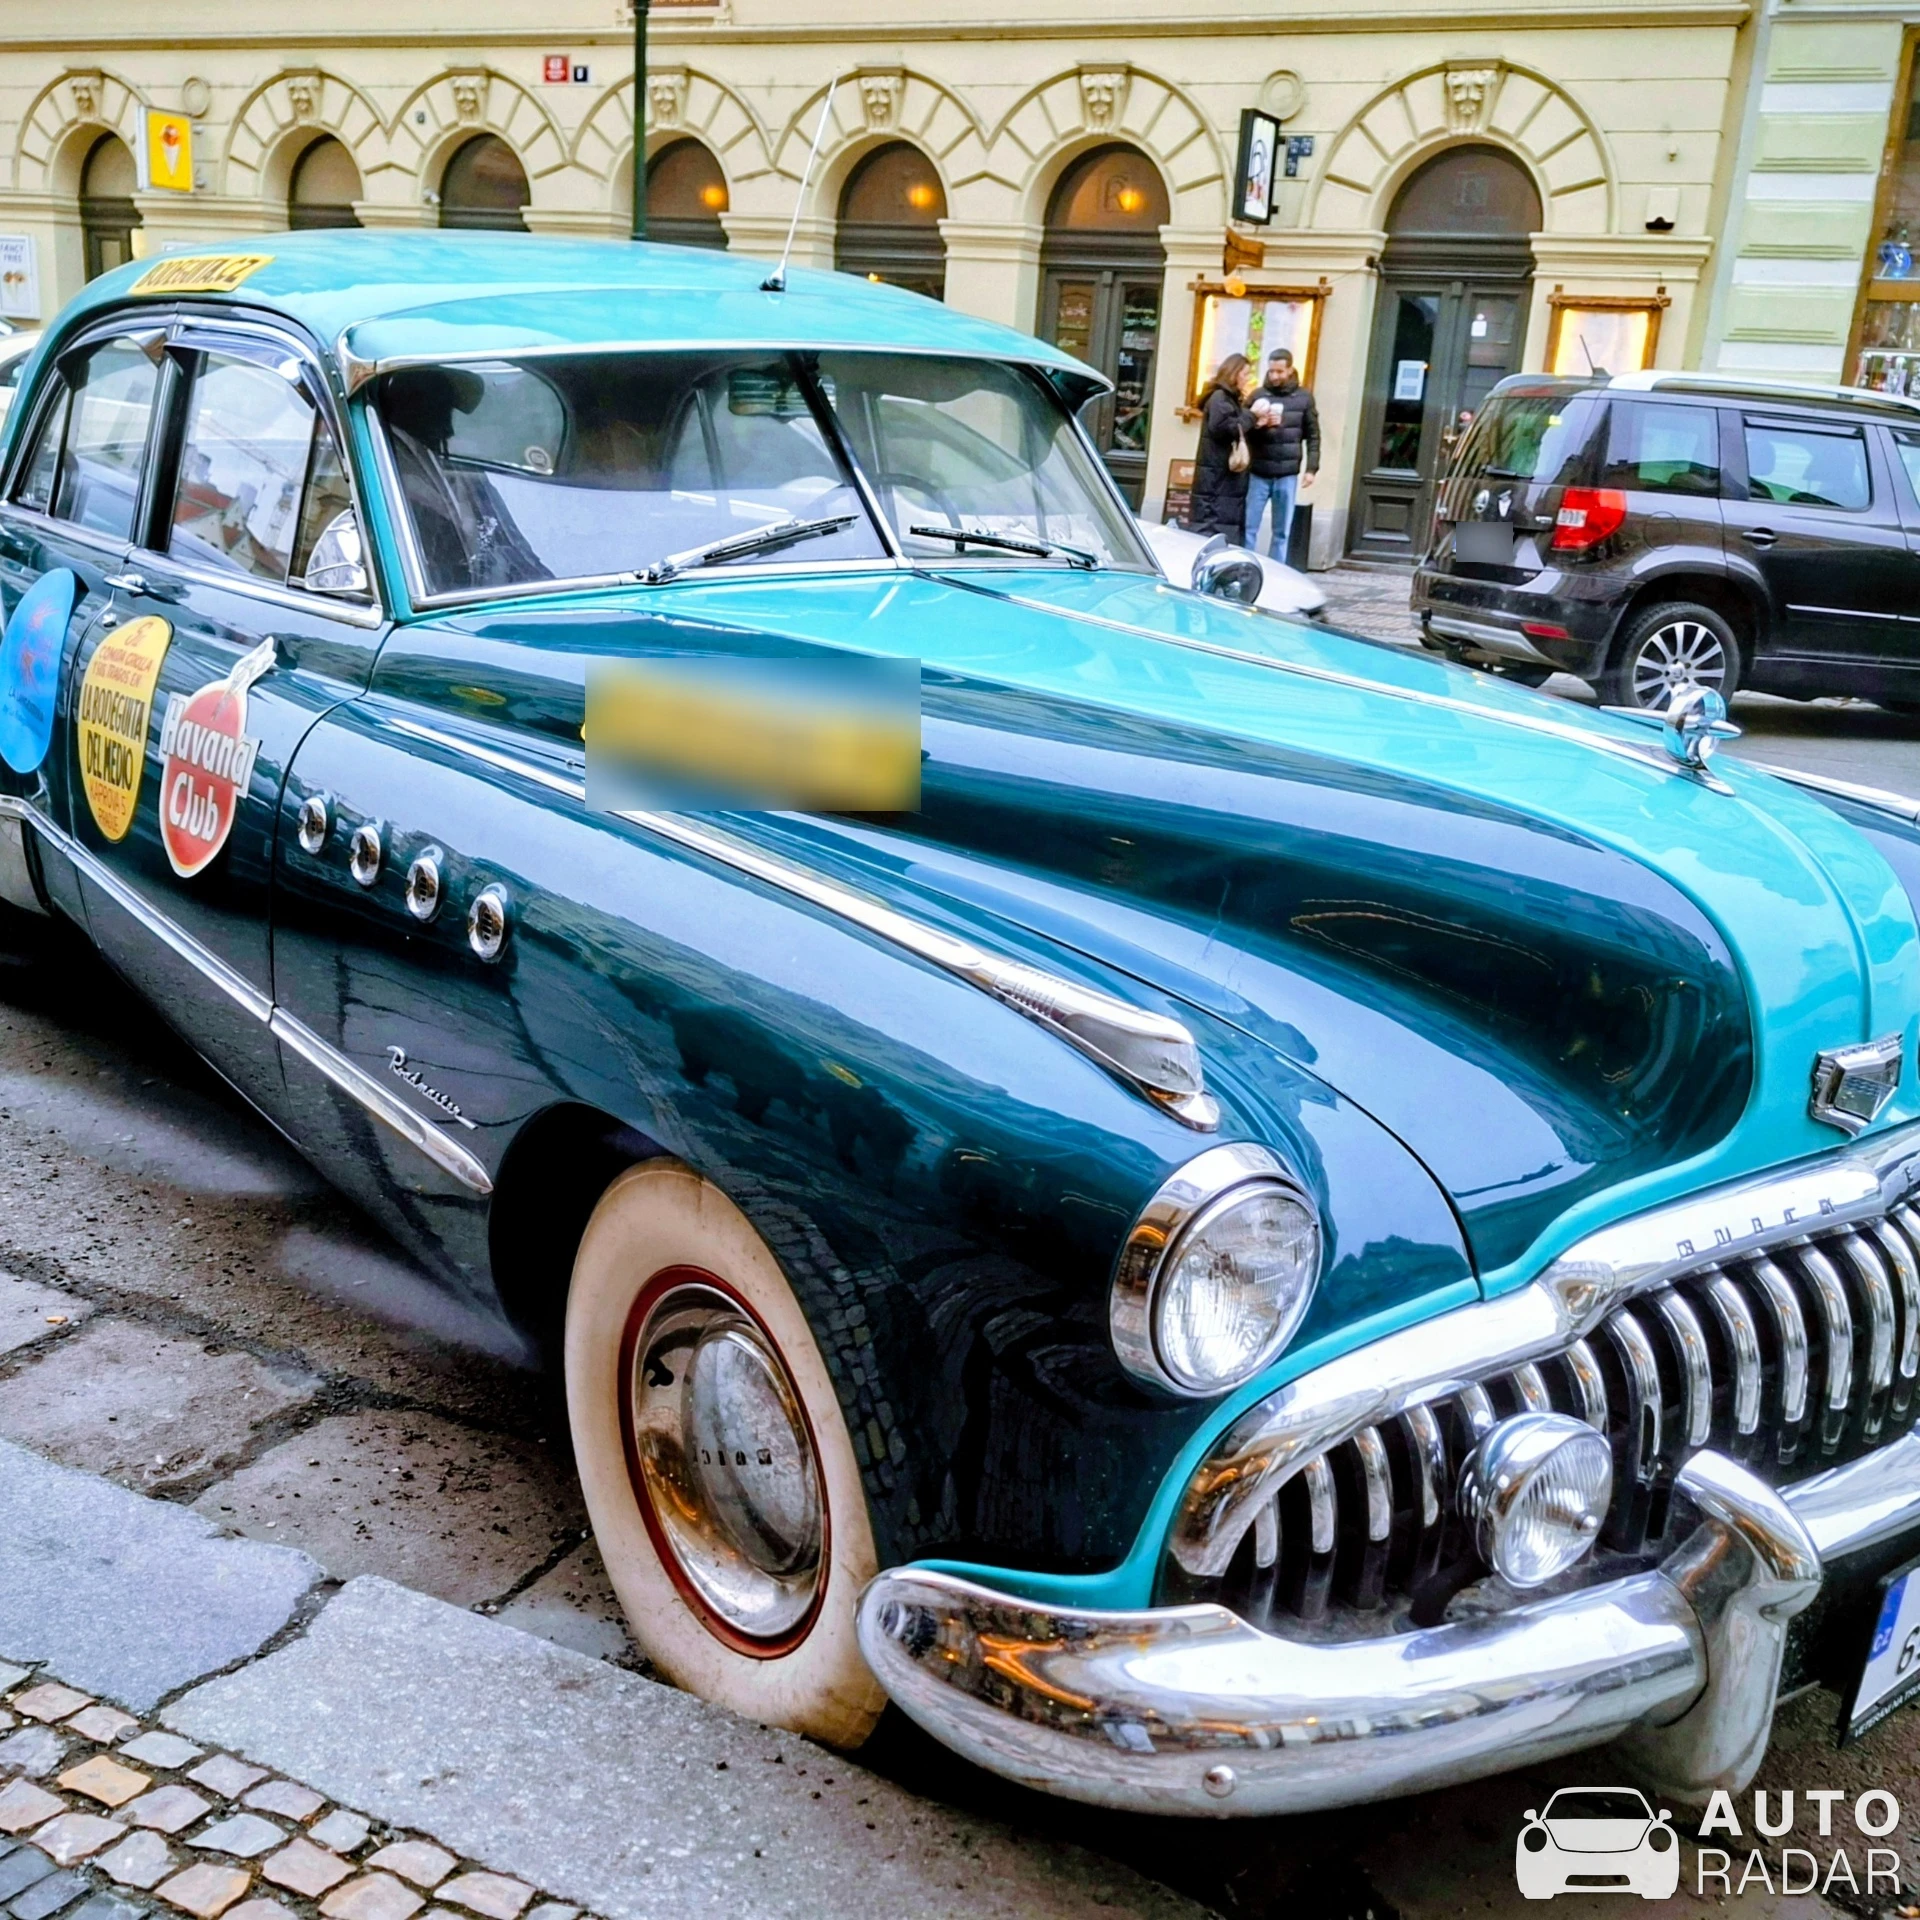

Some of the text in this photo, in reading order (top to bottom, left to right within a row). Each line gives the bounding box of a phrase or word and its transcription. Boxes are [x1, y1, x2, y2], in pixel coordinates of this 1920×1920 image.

[82, 683, 92, 721] LA
[91, 685, 145, 743] BODEGUITA
[162, 698, 253, 788] Havana
[86, 730, 134, 791] DEL MEDIO
[169, 771, 219, 842] Club
[1676, 1198, 1834, 1259] BUICK
[1873, 1626, 1893, 1652] CZ
[1896, 1625, 1920, 1676] 6
